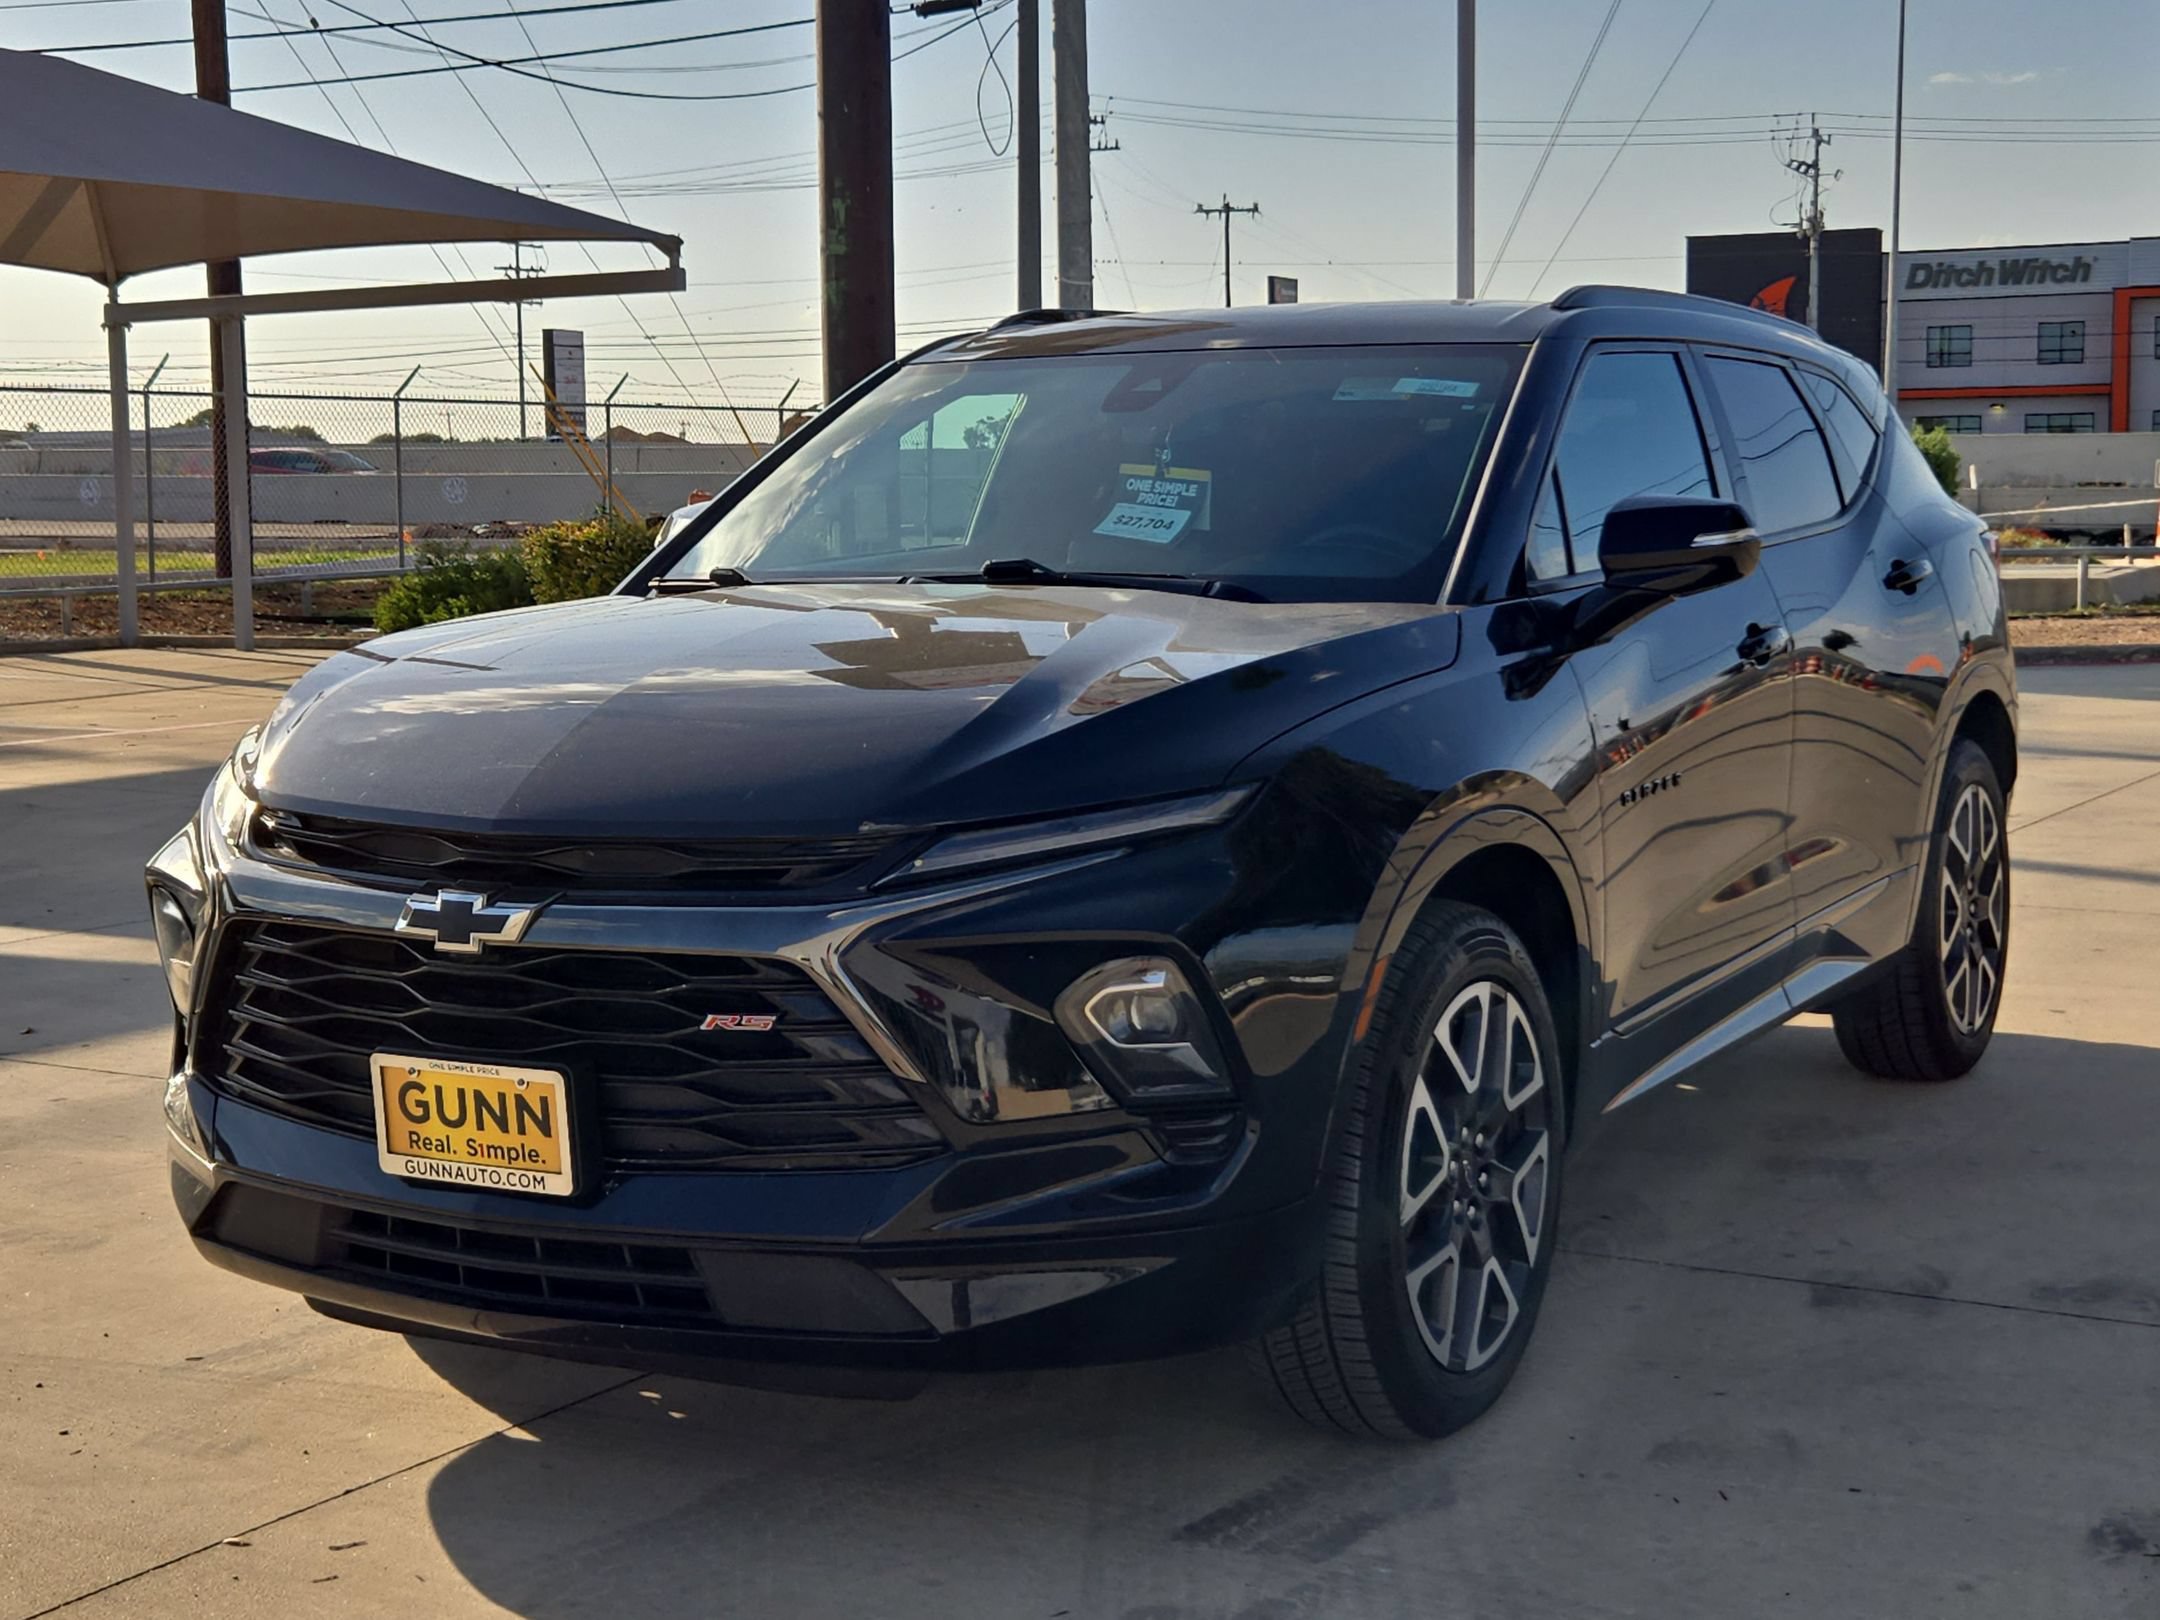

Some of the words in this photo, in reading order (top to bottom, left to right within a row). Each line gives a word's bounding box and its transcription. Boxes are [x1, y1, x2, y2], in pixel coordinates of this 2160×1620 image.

[1905, 260, 1995, 290] Ditch
[1998, 256, 2093, 285] Witch
[1125, 478, 1153, 492] ONE
[1153, 480, 1199, 497] SIMPLE
[1111, 514, 1175, 531] $27,704
[699, 1014, 777, 1031] RS
[428, 1061, 446, 1071] ONE
[447, 1063, 475, 1074] SIMPLE
[476, 1066, 500, 1076] PRICE
[398, 1080, 553, 1139] GUNN
[408, 1130, 458, 1156] Real.
[405, 1160, 547, 1190] GUNNAUTO.COM
